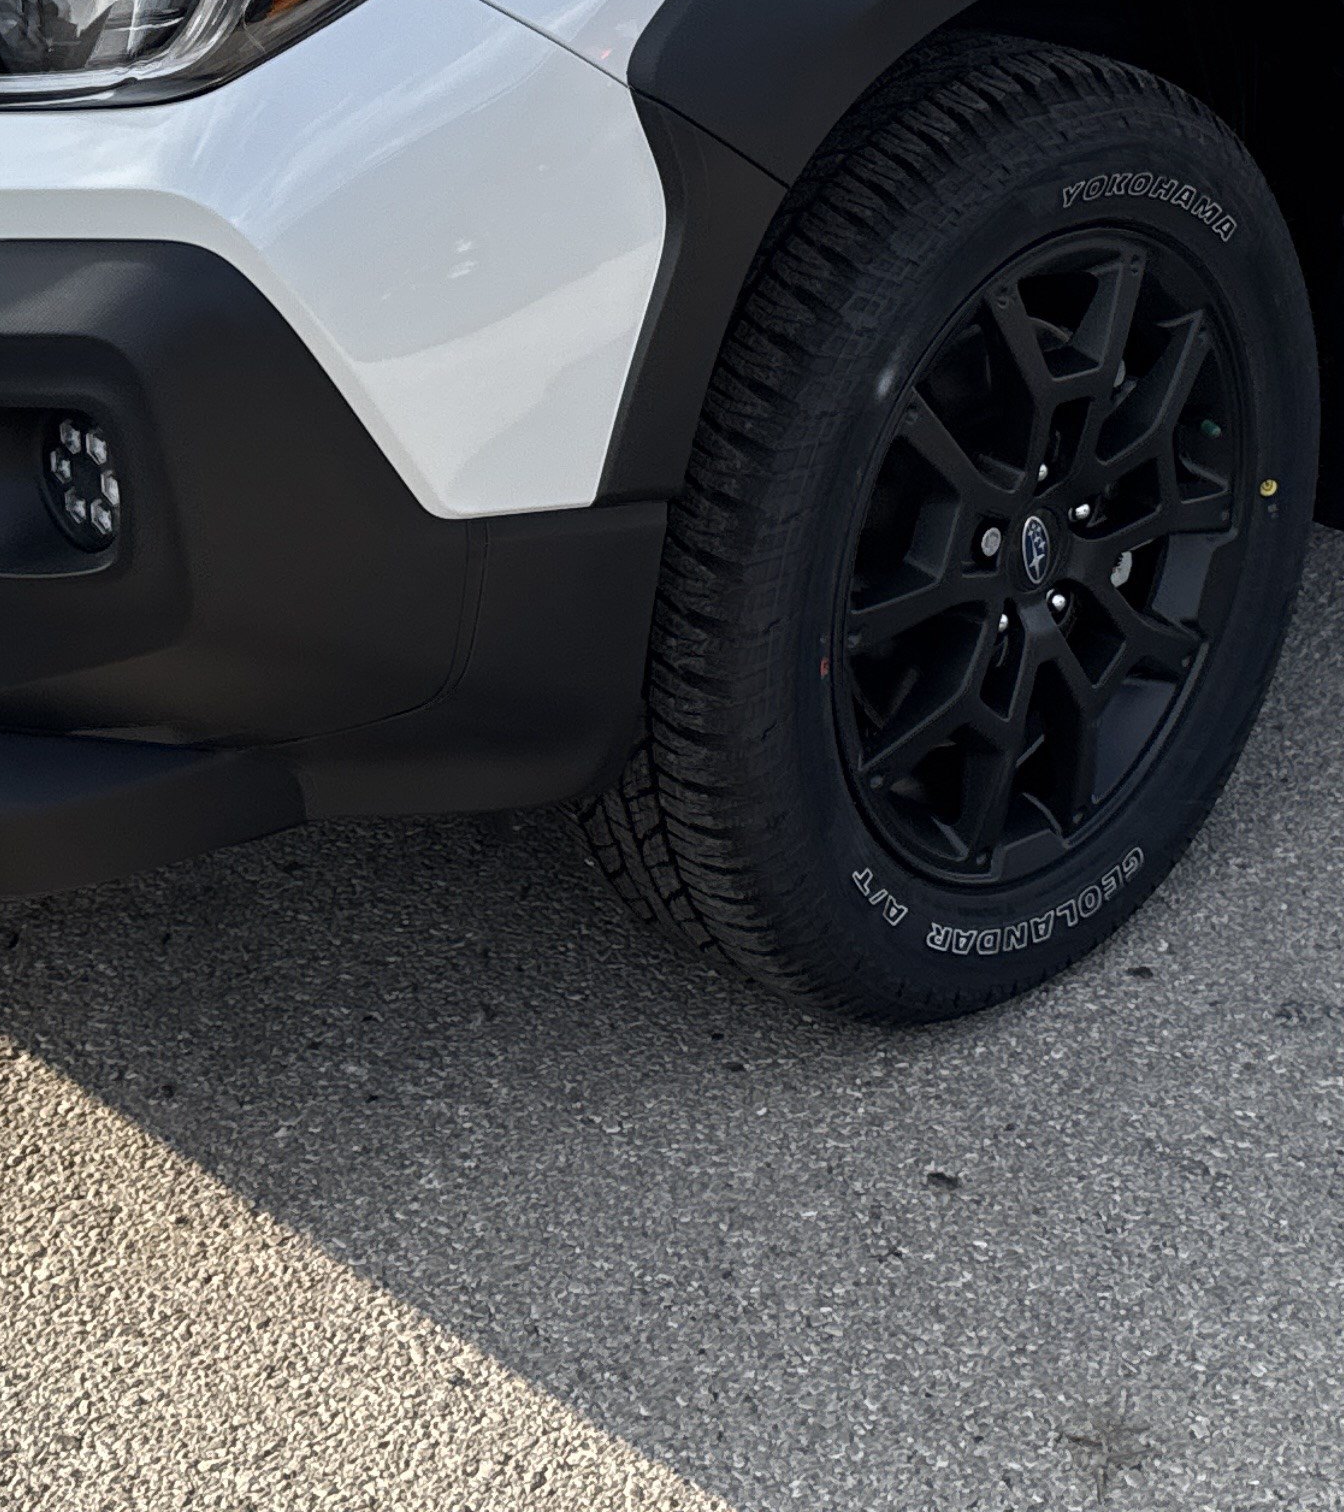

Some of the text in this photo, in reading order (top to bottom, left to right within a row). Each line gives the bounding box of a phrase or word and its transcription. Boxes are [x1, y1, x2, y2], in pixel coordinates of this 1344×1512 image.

[1062, 172, 1238, 243] YOKOHAMA
[851, 846, 1145, 956] GEOLANDAR A/T
